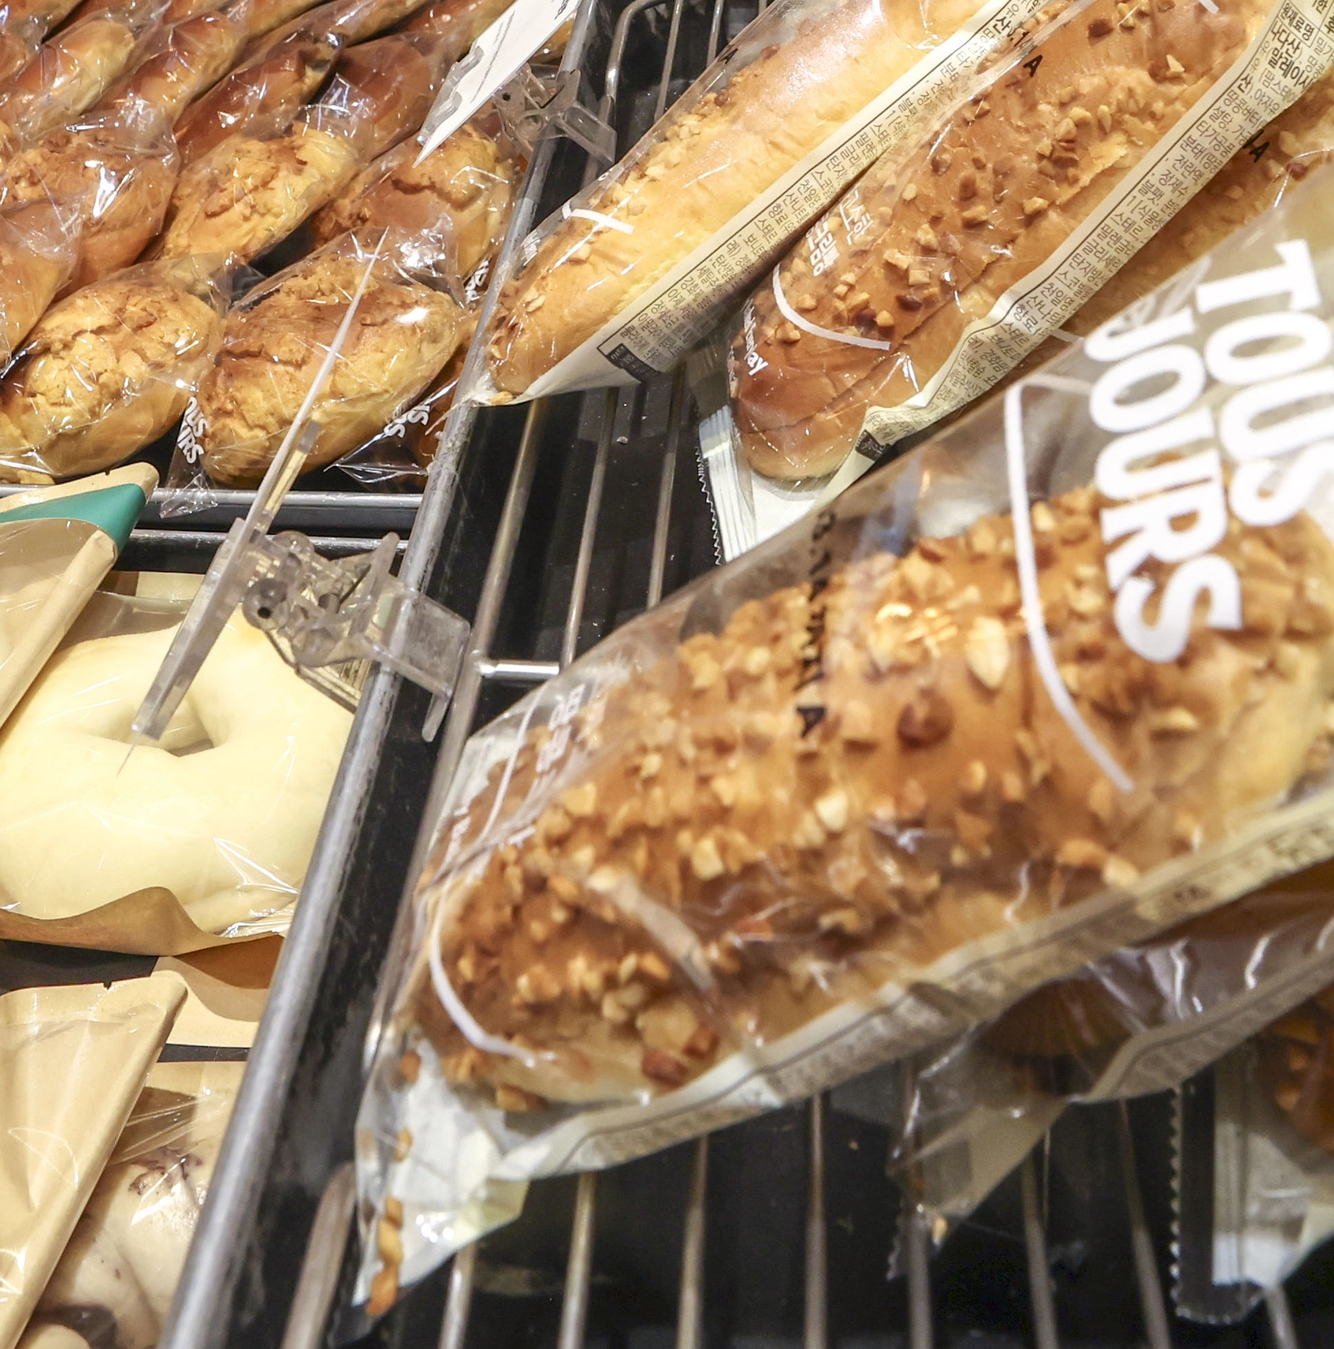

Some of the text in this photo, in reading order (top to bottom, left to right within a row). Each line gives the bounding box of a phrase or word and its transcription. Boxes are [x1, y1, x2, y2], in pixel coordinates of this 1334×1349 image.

[1278, 1, 1316, 42] 원재료명
[844, 186, 876, 240] 고소한
[1084, 306, 1243, 664] JOURS
